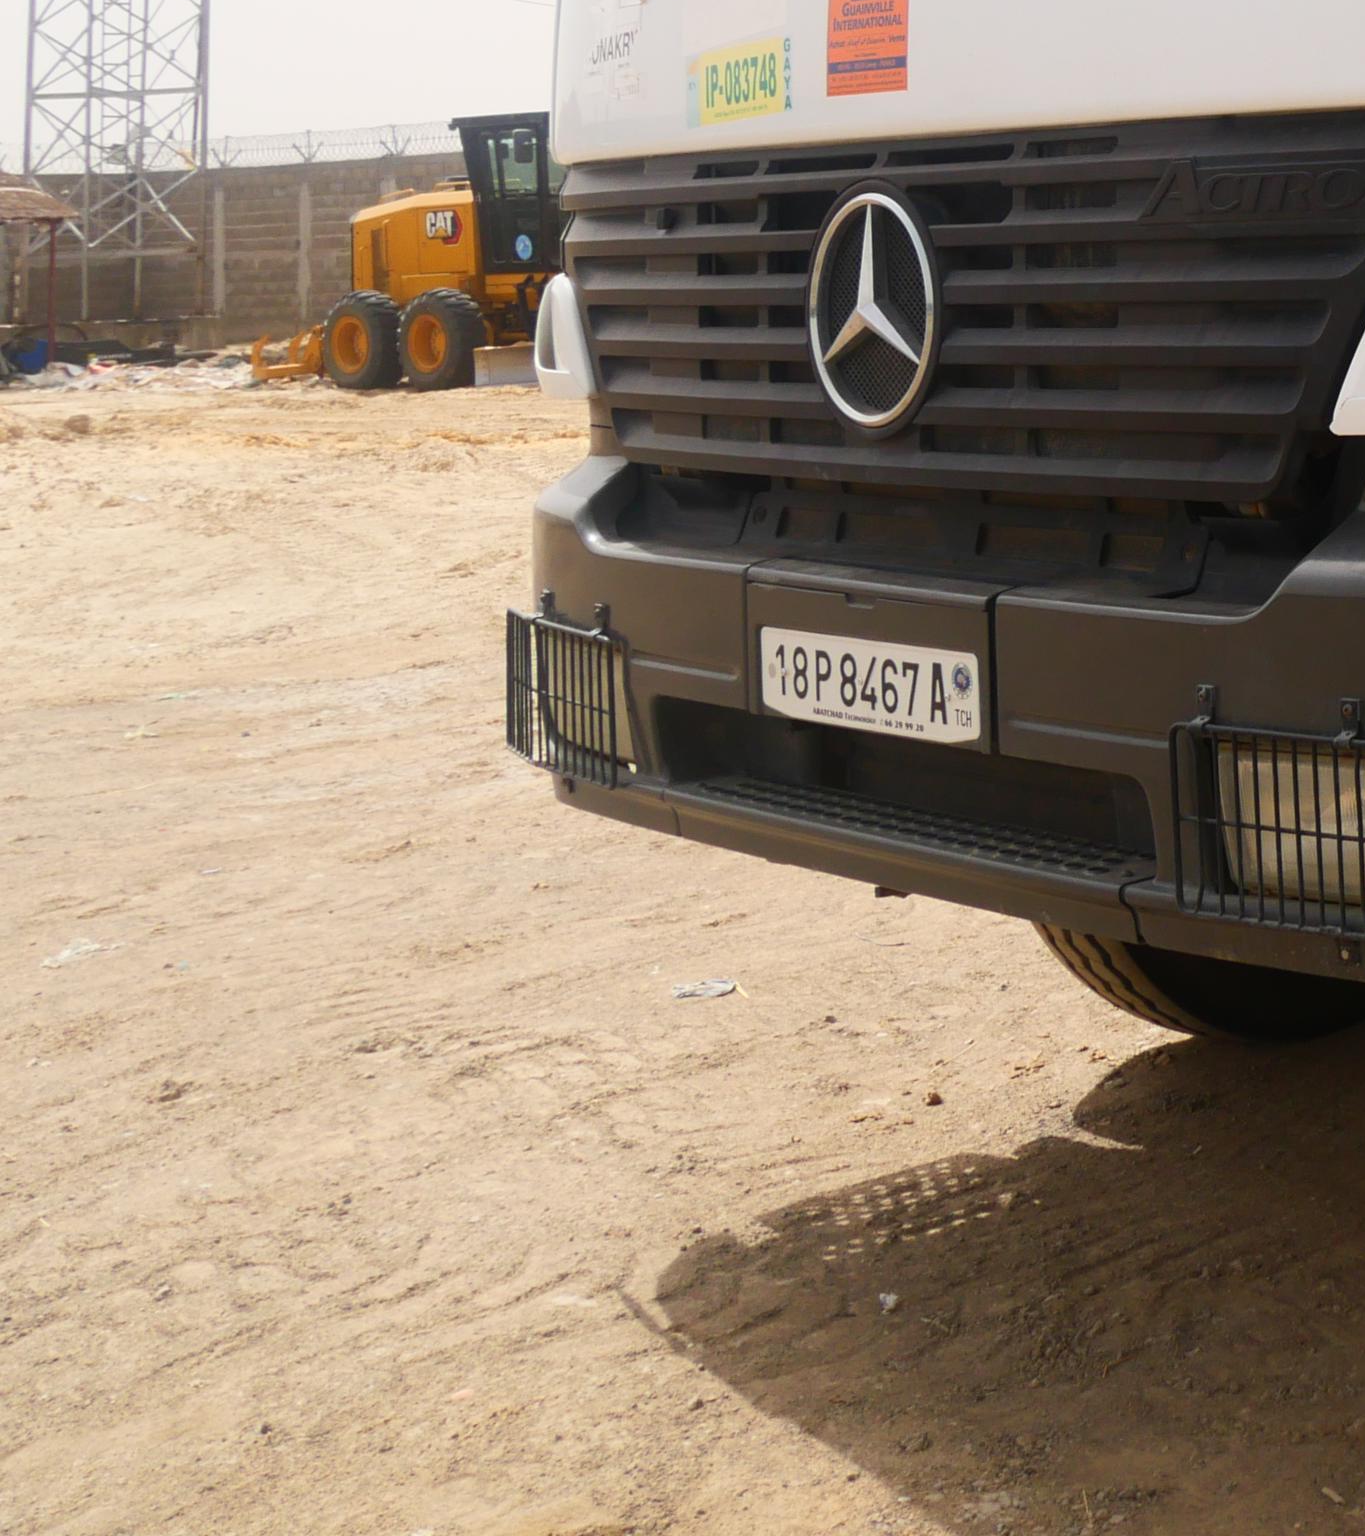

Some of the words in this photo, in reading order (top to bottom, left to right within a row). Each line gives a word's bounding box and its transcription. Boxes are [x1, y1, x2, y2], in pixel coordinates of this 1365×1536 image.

[833, 13, 902, 32] INTERNATIONAL
[784, 37, 792, 110] GAYA
[426, 210, 453, 238] CAT
[955, 708, 973, 728] TCH
